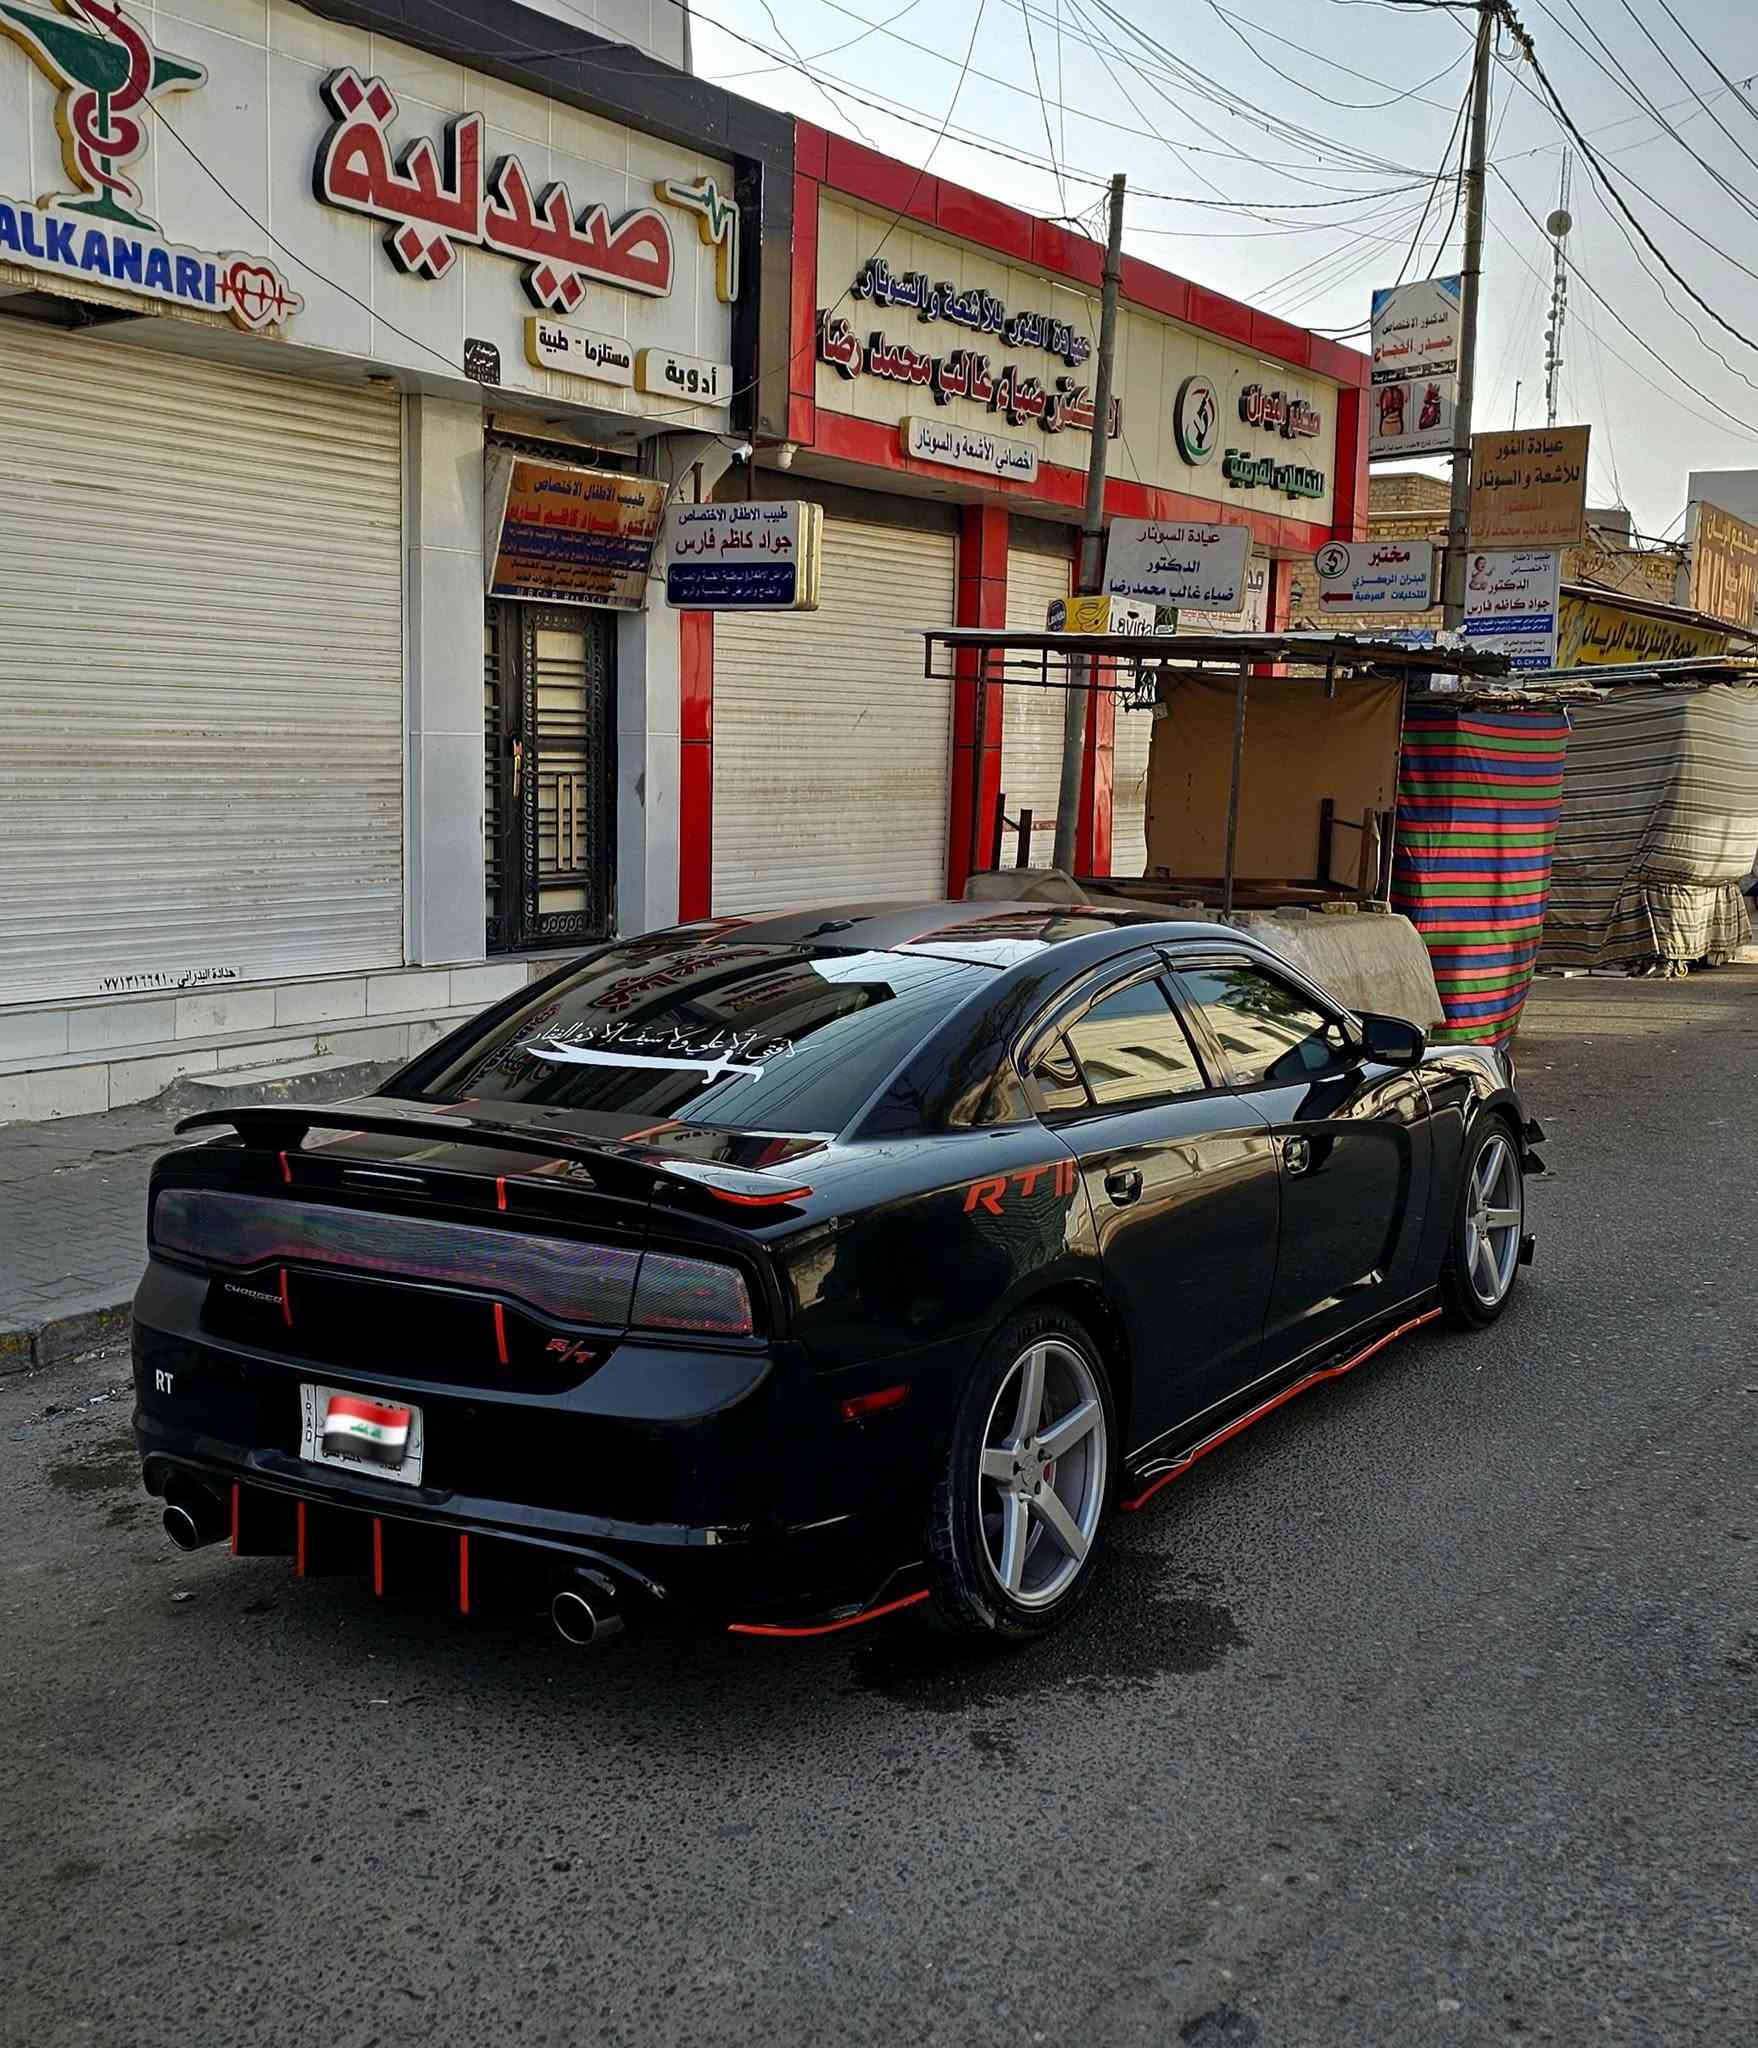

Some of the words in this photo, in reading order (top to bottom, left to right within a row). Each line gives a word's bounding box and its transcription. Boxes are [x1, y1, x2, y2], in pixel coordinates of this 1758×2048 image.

[316, 66, 674, 314] صيدلية
[0, 204, 217, 304] ALKANARI
[539, 326, 569, 353] طبية
[817, 308, 864, 379] رضا
[574, 339, 630, 367] مستلزما
[865, 331, 933, 385] محمد
[932, 350, 993, 405] غالب
[1038, 376, 1121, 439] الكتور
[962, 436, 993, 460] الأشعة
[1495, 440, 1524, 460] النور
[1528, 437, 1564, 458] عيادة
[678, 508, 726, 525] الاختصاص
[729, 507, 760, 524] الاطفال
[764, 506, 788, 523] طبيب
[675, 527, 715, 554] فارس
[721, 528, 753, 560] كاظم
[759, 530, 793, 556] جواد
[1137, 527, 1184, 545] السونار
[1188, 527, 1220, 546] عيادة
[1146, 556, 1200, 573] الدكتور
[1368, 546, 1410, 566] مختبر
[1109, 579, 1131, 594] رضا
[1132, 581, 1166, 594] محمد
[1169, 584, 1200, 602] غالب
[1203, 587, 1235, 604] ضياء
[1488, 578, 1529, 594] الدكتور
[1467, 600, 1492, 615] فارس
[1494, 599, 1525, 613] كاظم
[1529, 598, 1550, 612] جواد
[155, 1368, 174, 1395] RT
